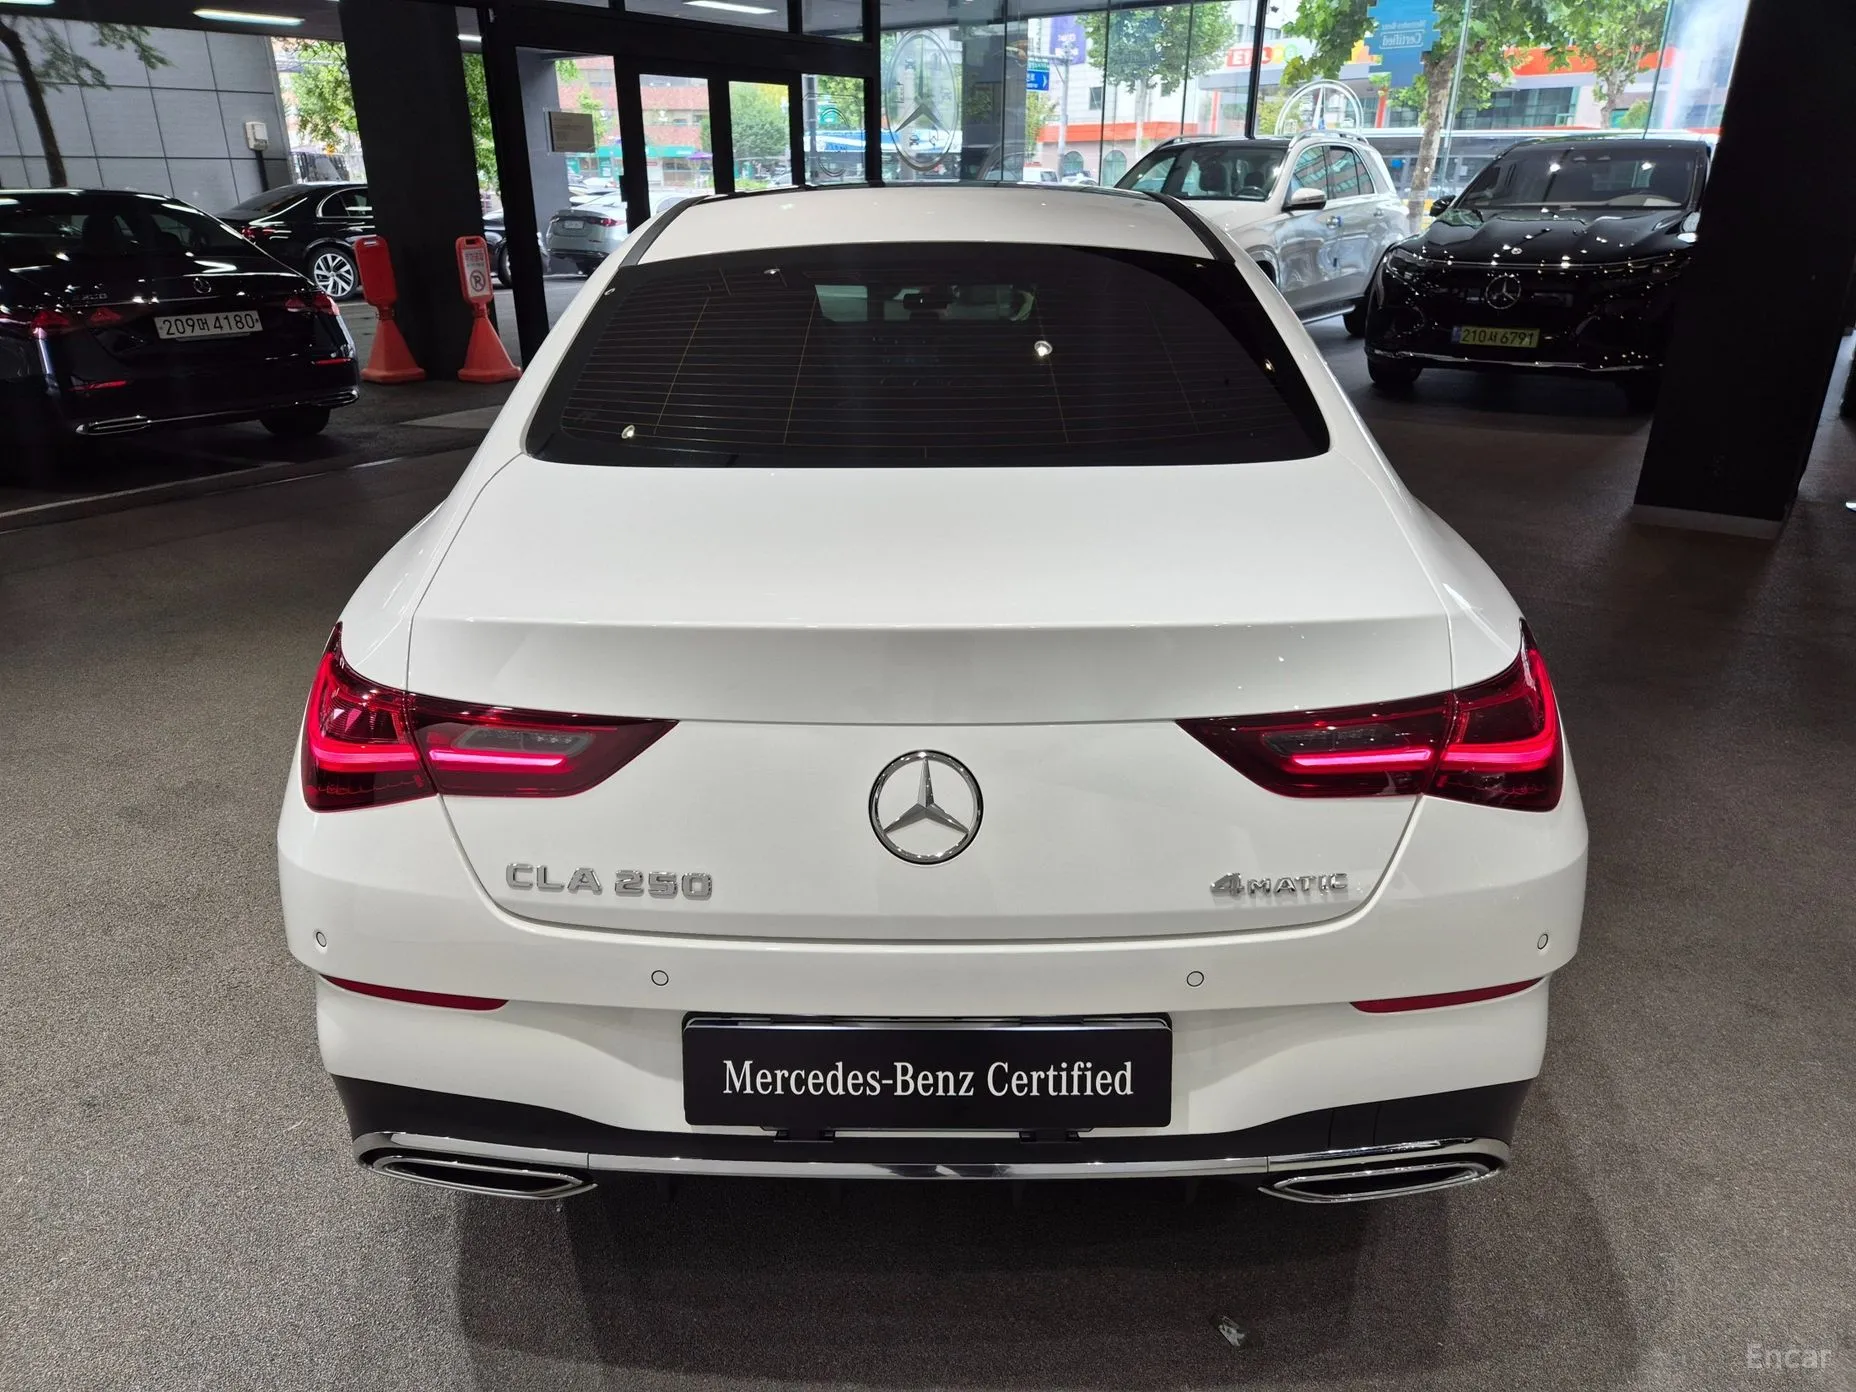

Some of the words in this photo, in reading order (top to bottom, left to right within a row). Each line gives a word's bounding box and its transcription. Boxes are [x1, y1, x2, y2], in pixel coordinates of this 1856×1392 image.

[213, 313, 256, 332] 4180
[1500, 331, 1534, 346] 6791
[505, 863, 603, 895] CLA
[614, 869, 713, 901] 250
[1210, 872, 1348, 898] 4MATIC
[722, 1060, 975, 1097] Mercedes-Benz
[986, 1060, 1134, 1097] Certified
